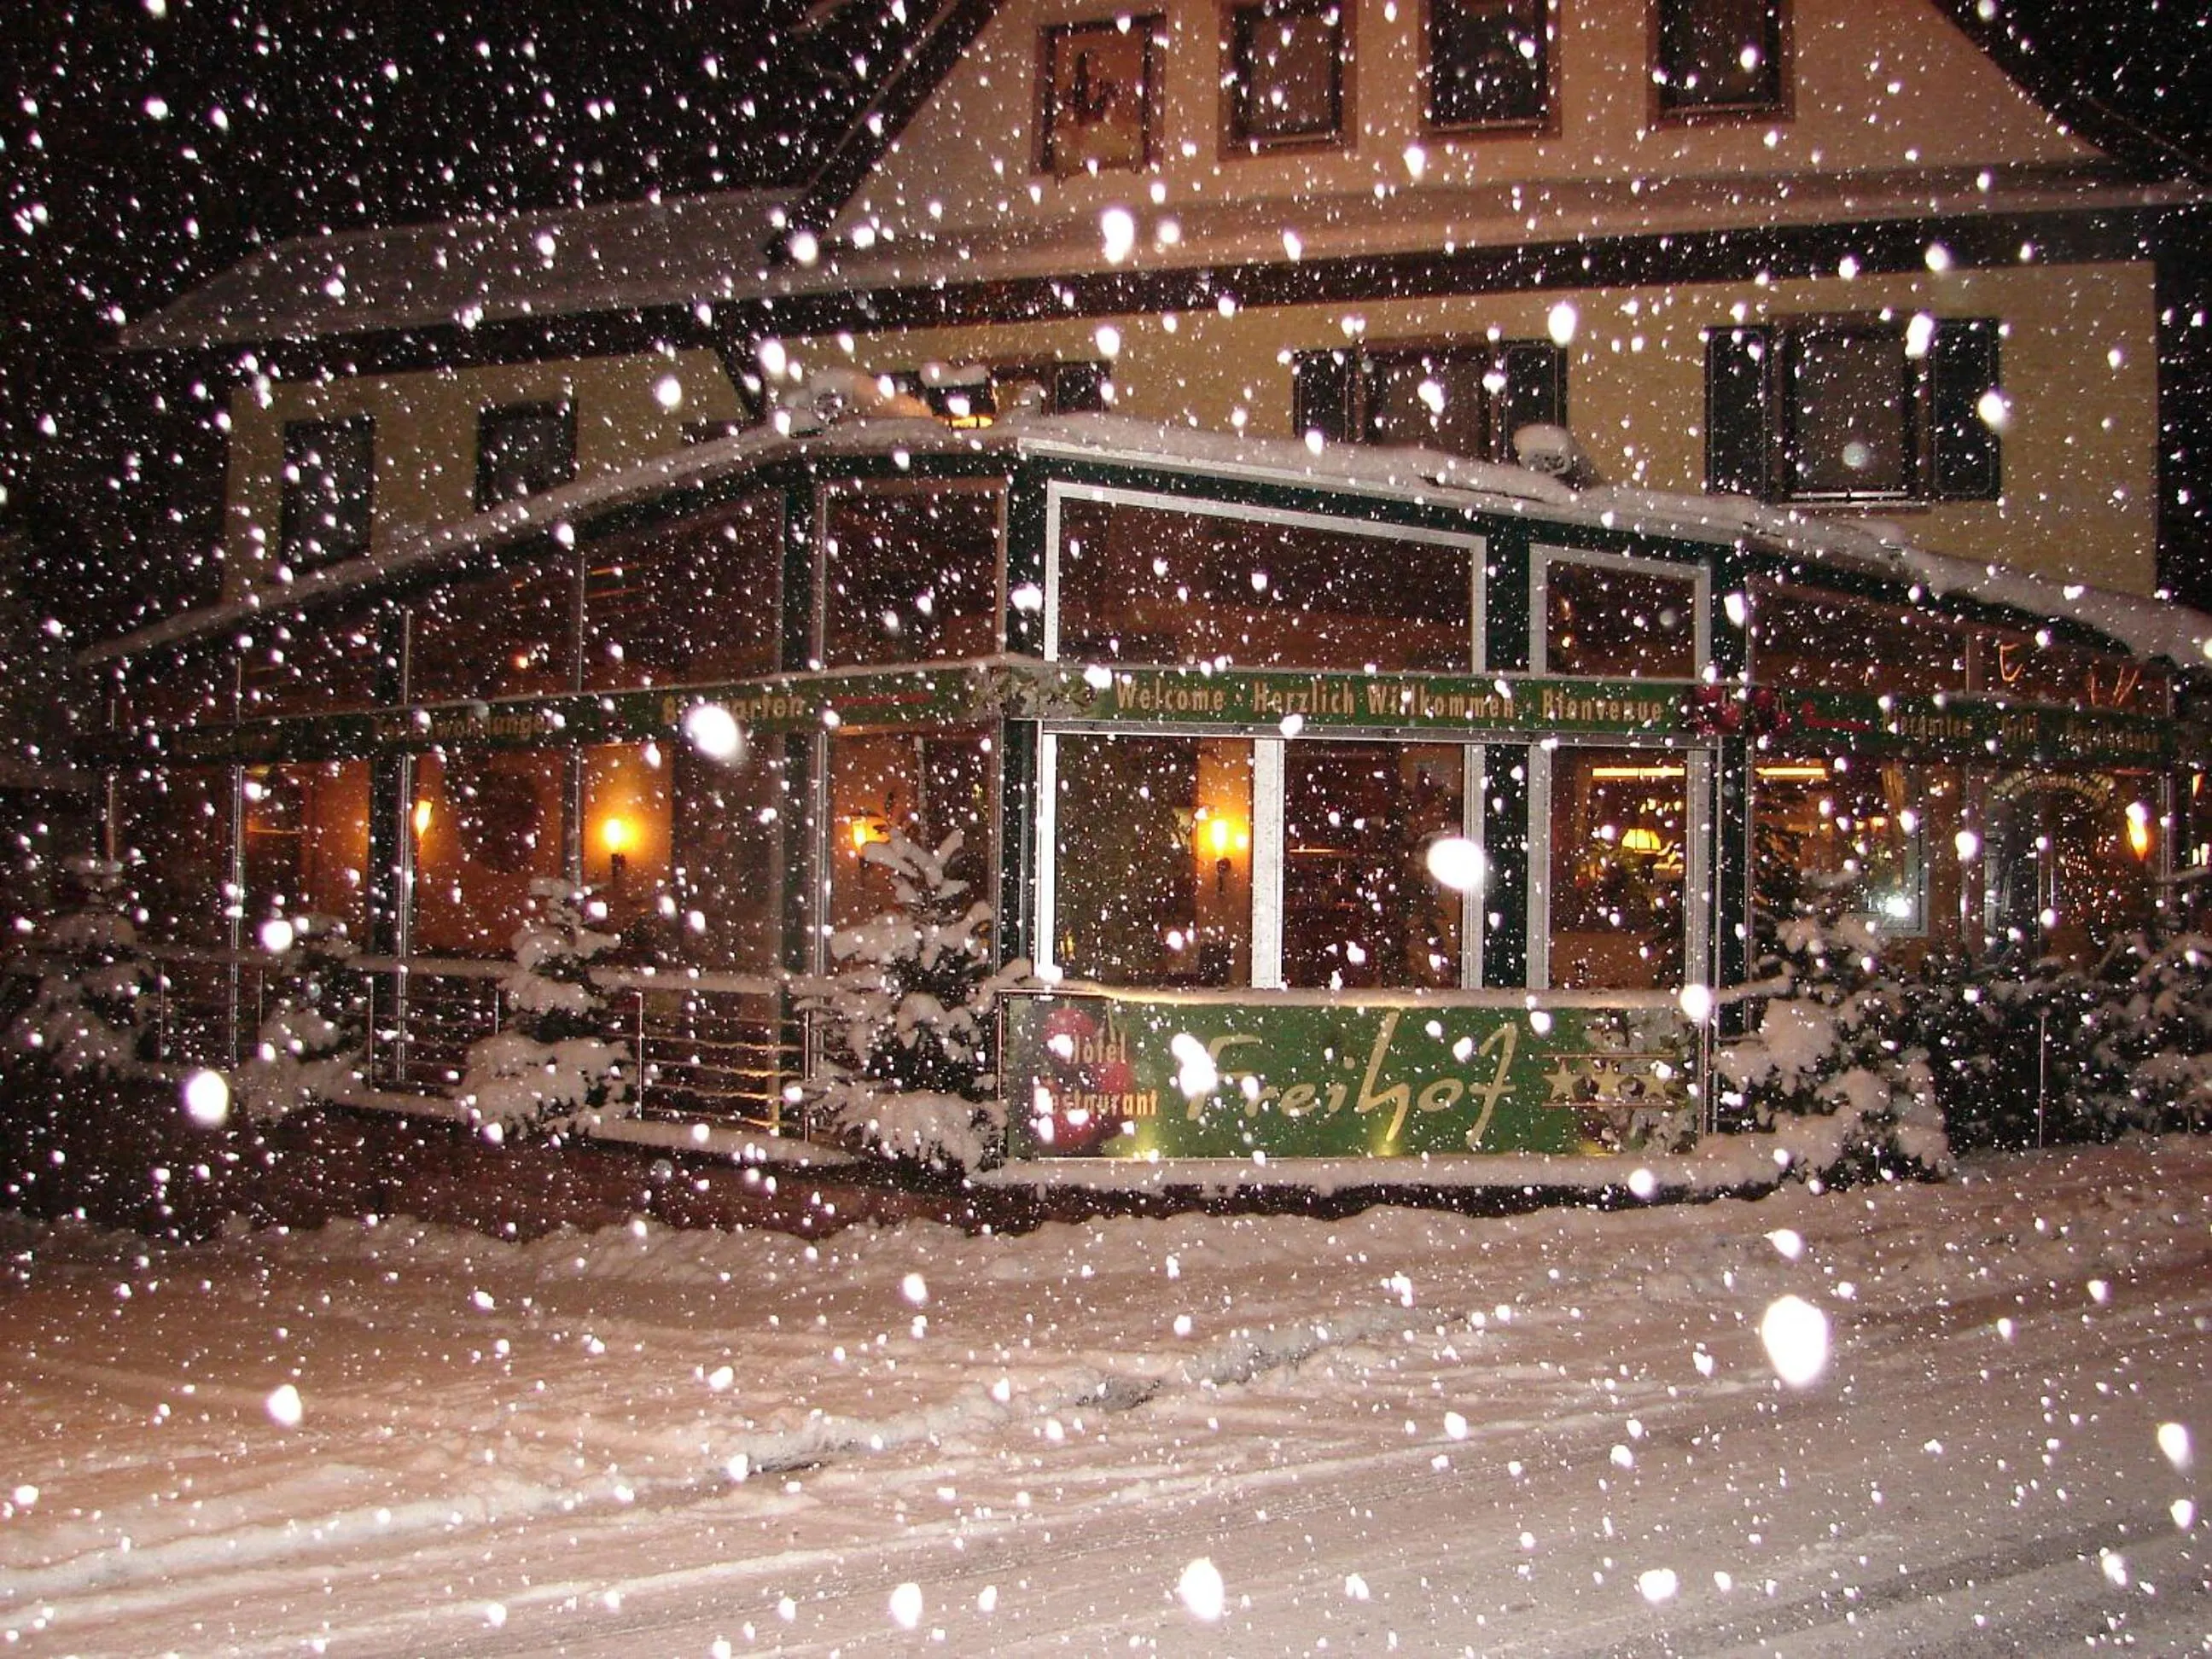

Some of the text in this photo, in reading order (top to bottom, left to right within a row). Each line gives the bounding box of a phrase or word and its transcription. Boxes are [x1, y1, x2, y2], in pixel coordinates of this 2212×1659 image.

[1115, 679, 1224, 712] Welcome
[1253, 680, 1357, 714] Herzlich
[1367, 682, 1516, 719] Willkommen
[1185, 1010, 1518, 1147] Freihof
[1035, 1089, 1159, 1117] estaurant
